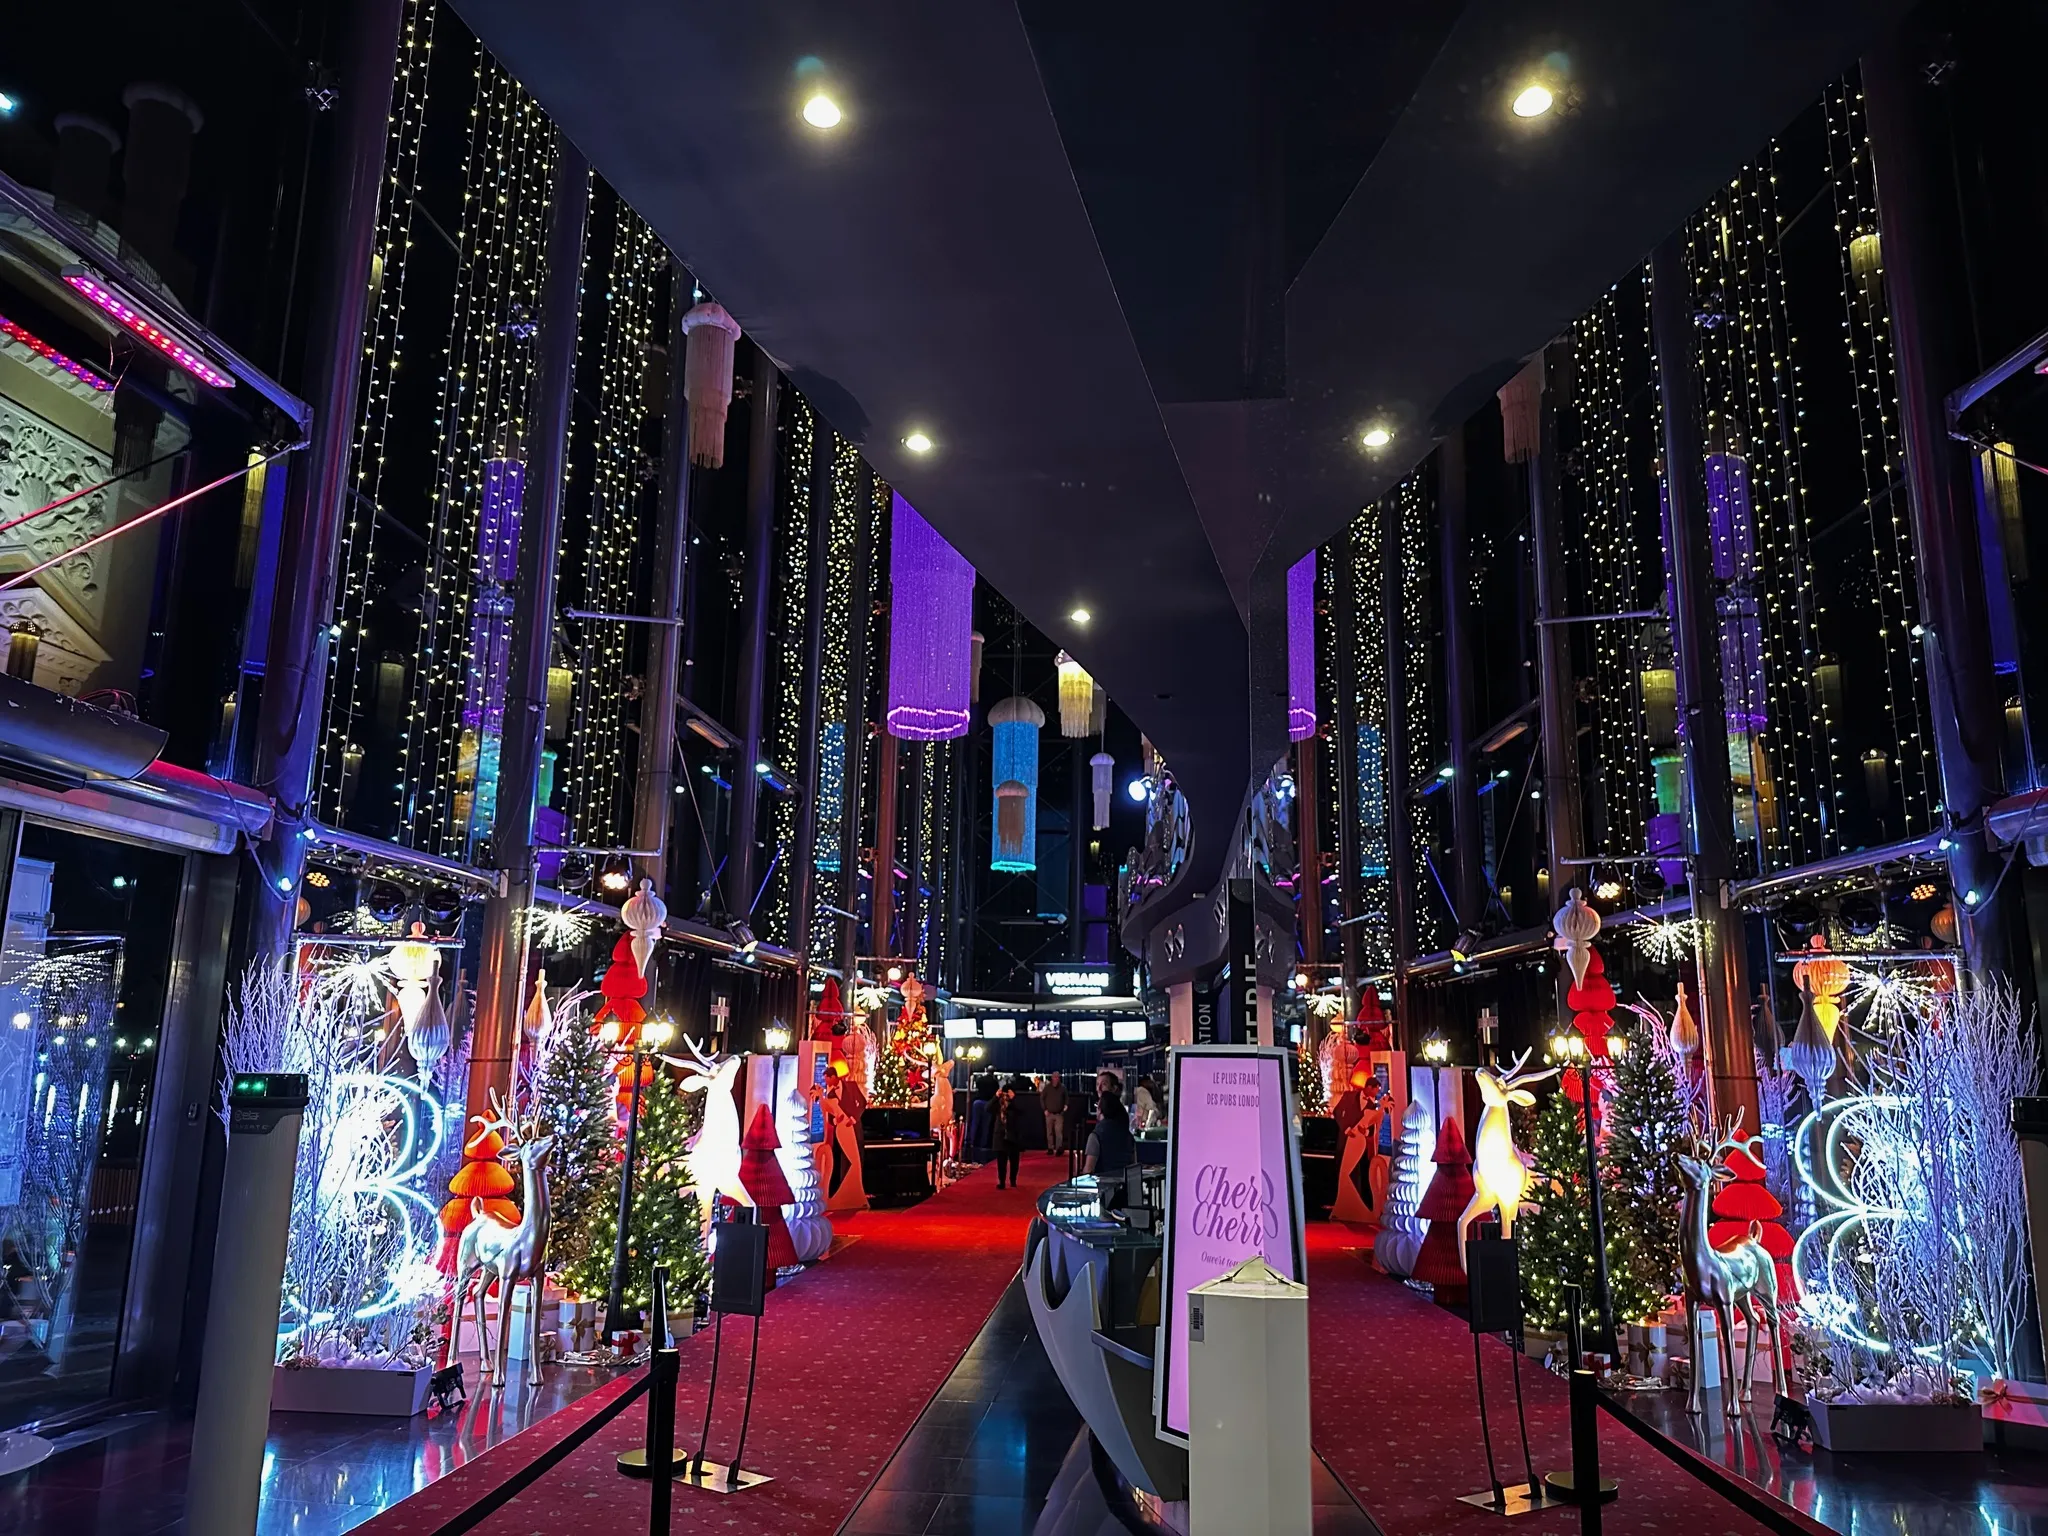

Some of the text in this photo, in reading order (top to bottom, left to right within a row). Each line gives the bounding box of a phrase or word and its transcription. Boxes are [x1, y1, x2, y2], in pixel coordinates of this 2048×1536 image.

[1213, 1072, 1220, 1084] LE
[1221, 1072, 1237, 1085] PLUS
[1206, 1093, 1218, 1105] DES
[1219, 1093, 1237, 1106] PUBS
[1195, 1164, 1263, 1212] Cher
[1192, 1200, 1264, 1247] Cherr
